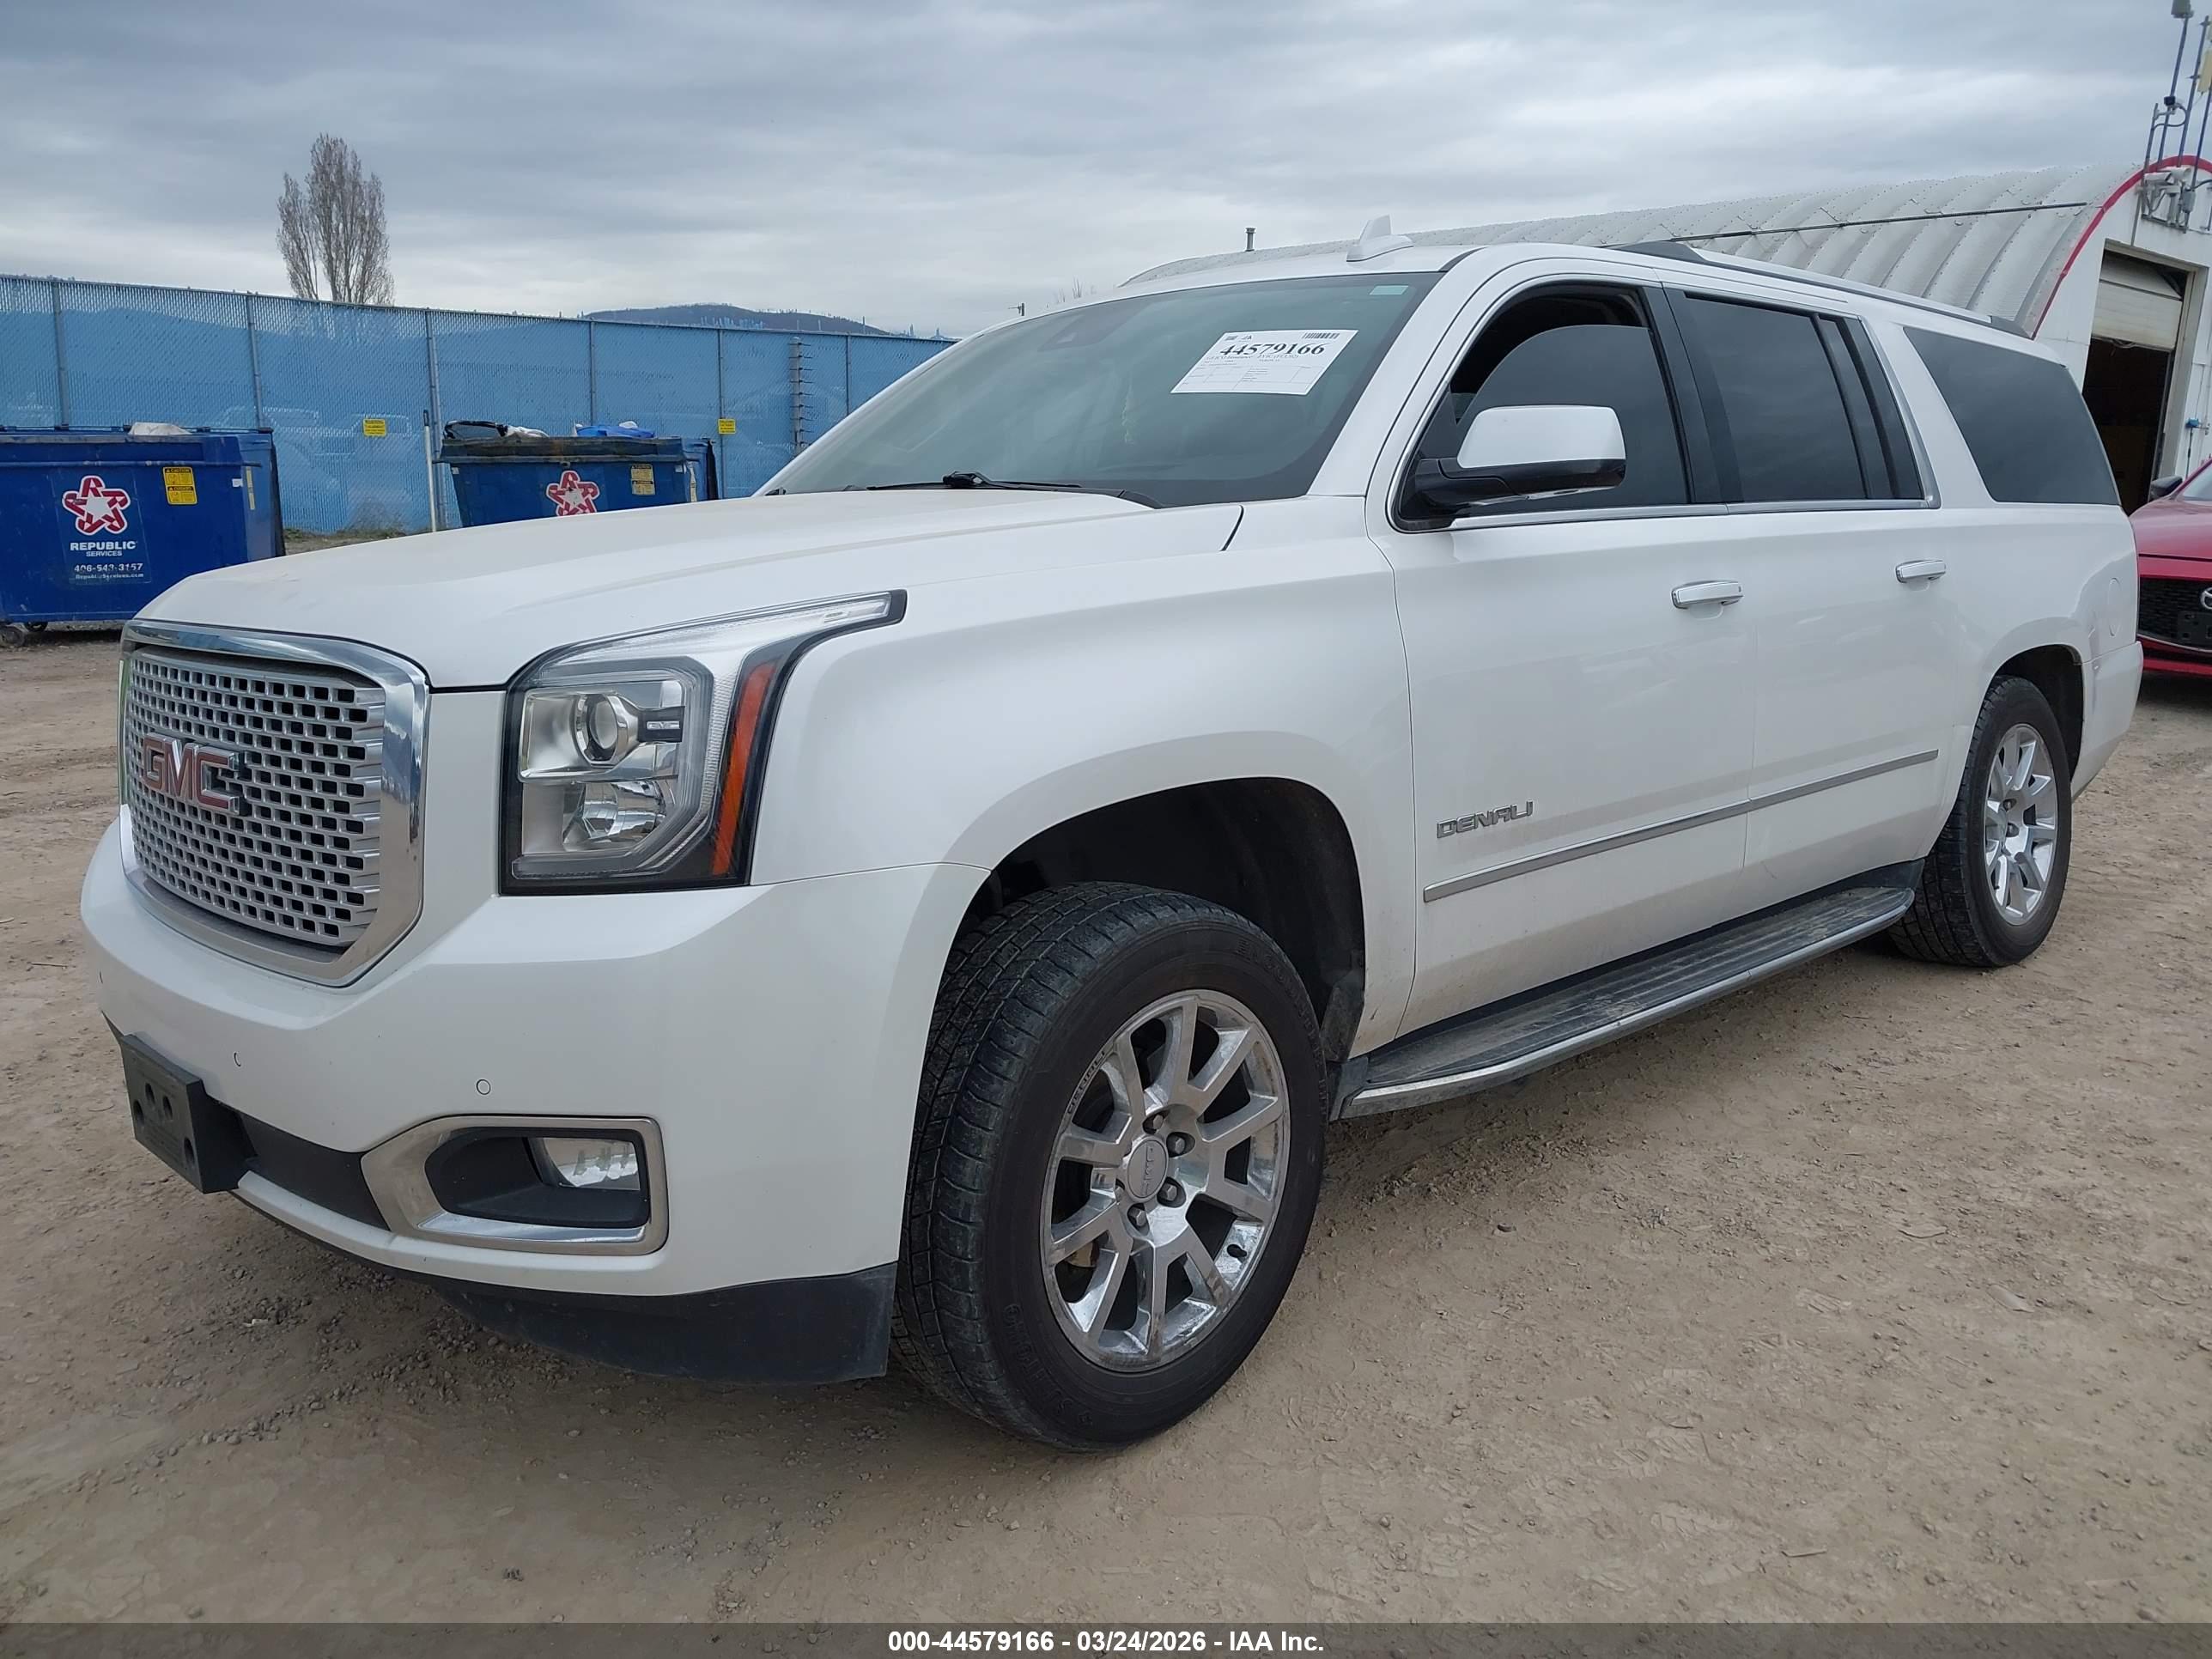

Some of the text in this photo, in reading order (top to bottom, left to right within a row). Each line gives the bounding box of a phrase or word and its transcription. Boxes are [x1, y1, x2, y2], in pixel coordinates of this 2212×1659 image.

[1220, 343, 1330, 356] 44579166
[70, 541, 137, 550] REPUBLIC
[143, 732, 240, 816] GMC
[1437, 799, 1534, 839] DENALI
